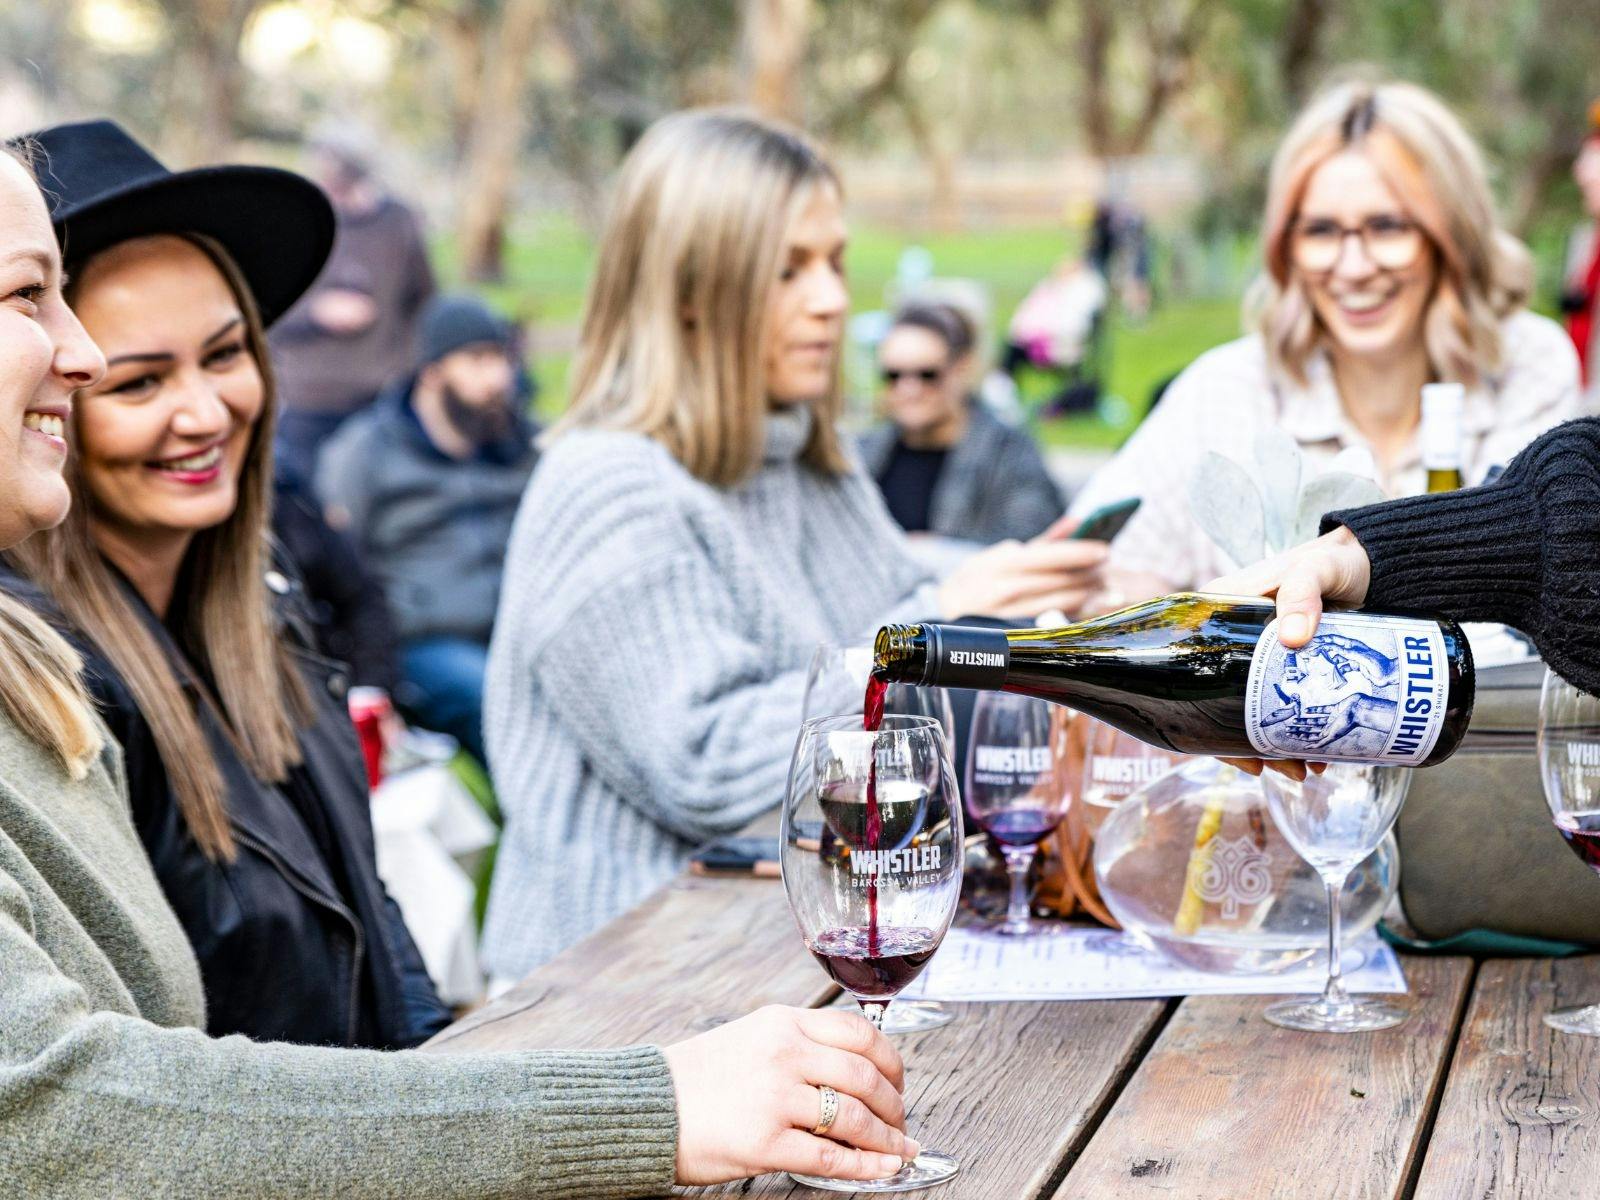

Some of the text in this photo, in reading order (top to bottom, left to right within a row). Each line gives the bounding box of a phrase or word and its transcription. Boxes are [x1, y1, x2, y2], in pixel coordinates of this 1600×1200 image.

[950, 651, 1005, 667] WHISTLER
[1387, 636, 1433, 756] WHISTLER
[1435, 684, 1444, 710] SHIRAZ
[976, 746, 1053, 772] WHISTLER
[1567, 743, 1600, 765] WHI
[850, 845, 941, 874] WHISTLER
[851, 873, 941, 888] BAROSSA VALLEY
